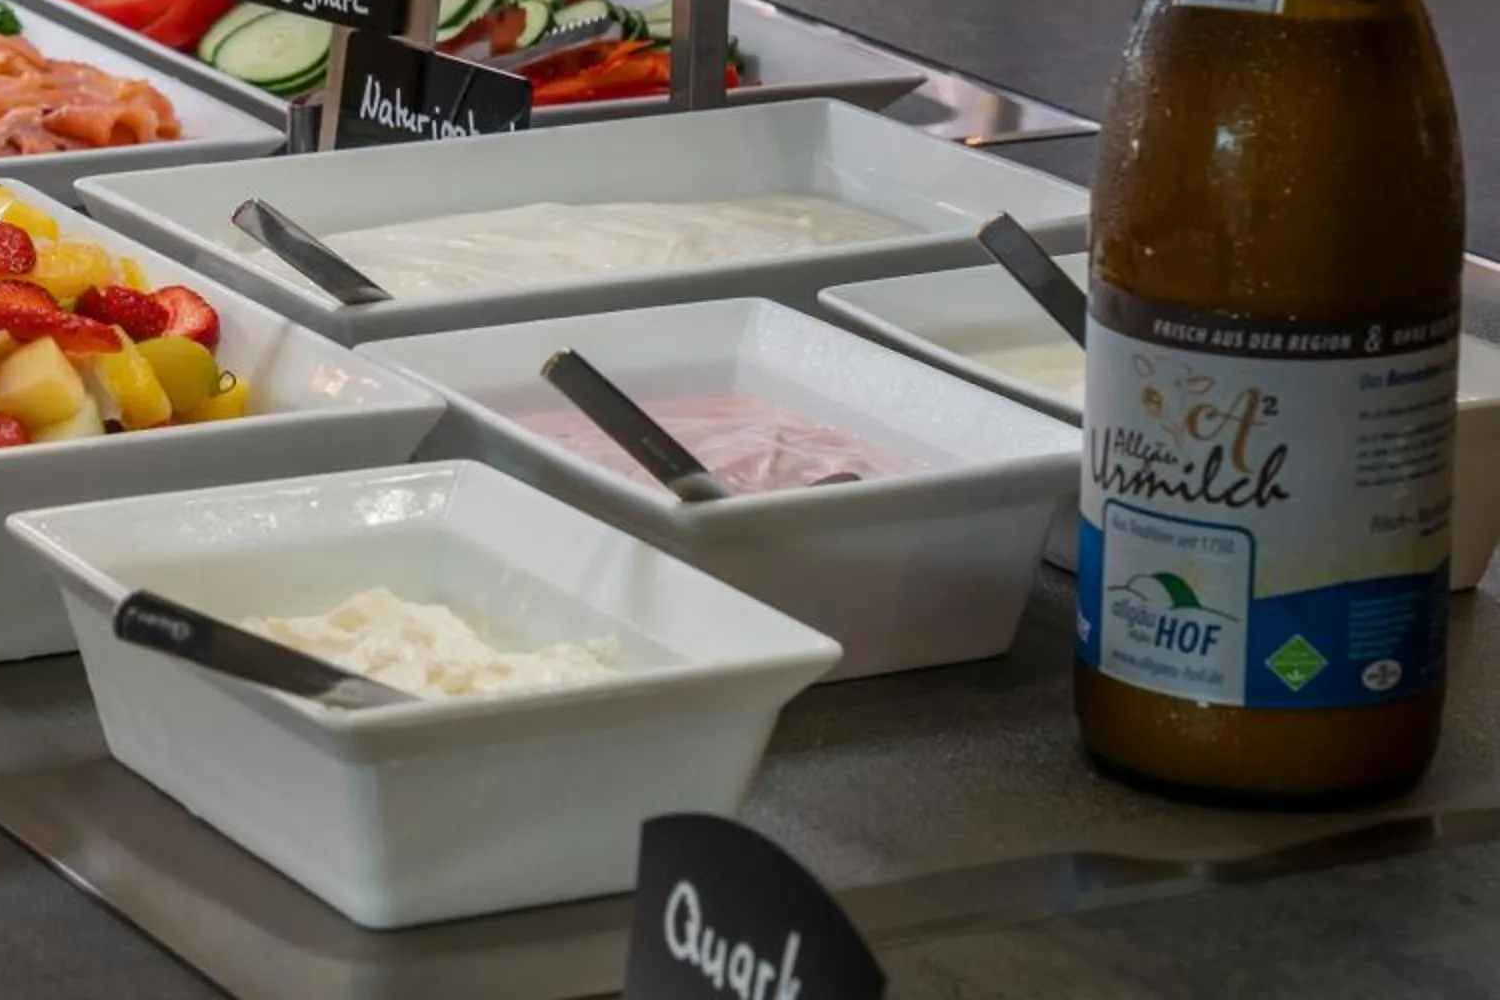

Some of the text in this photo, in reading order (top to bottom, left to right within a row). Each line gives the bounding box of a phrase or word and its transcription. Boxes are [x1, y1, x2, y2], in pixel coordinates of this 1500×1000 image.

[1153, 319, 1207, 343] FRISCH
[1210, 328, 1244, 349] AUS
[1248, 332, 1284, 350] DER
[1286, 334, 1353, 352] REGION
[1091, 426, 1290, 509] Urmilch
[1155, 614, 1222, 656] HOF
[663, 879, 802, 1000] Quark
